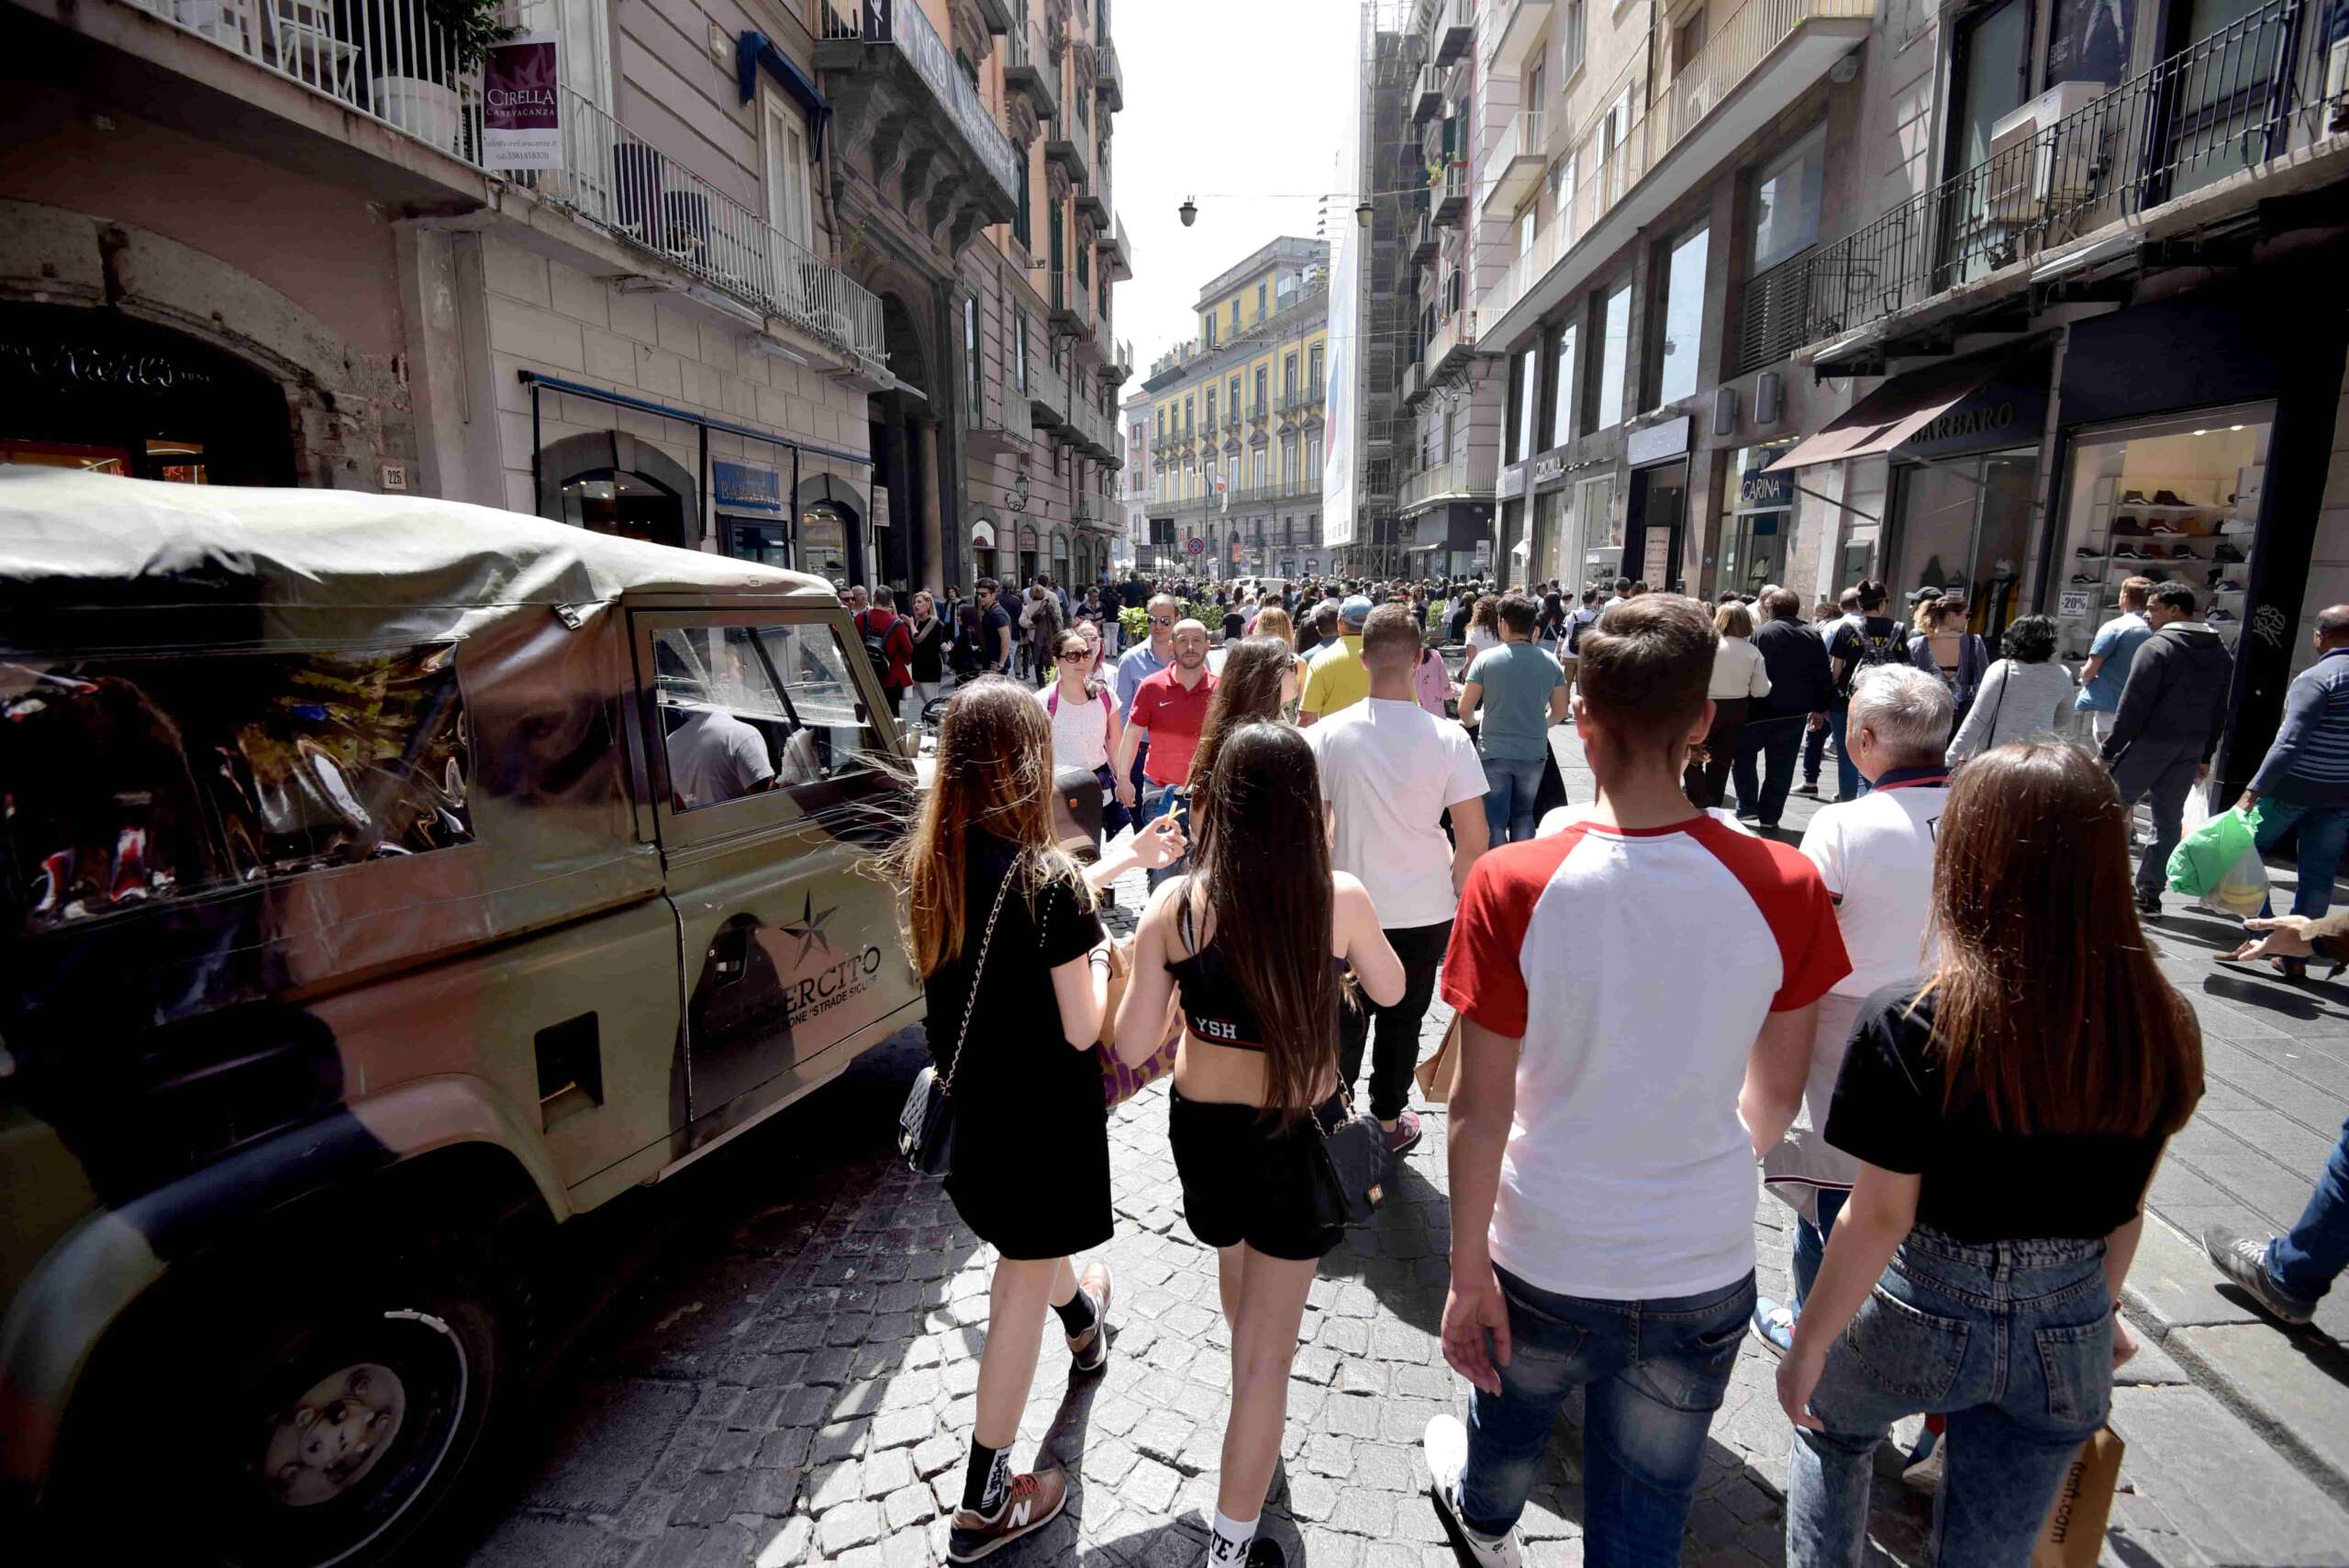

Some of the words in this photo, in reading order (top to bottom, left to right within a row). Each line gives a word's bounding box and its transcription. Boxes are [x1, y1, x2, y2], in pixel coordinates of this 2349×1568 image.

[487, 88, 555, 106] CIRELLA
[387, 470, 402, 484] 225
[1742, 477, 1780, 500] CARINA
[1195, 1017, 1237, 1040] YSH
